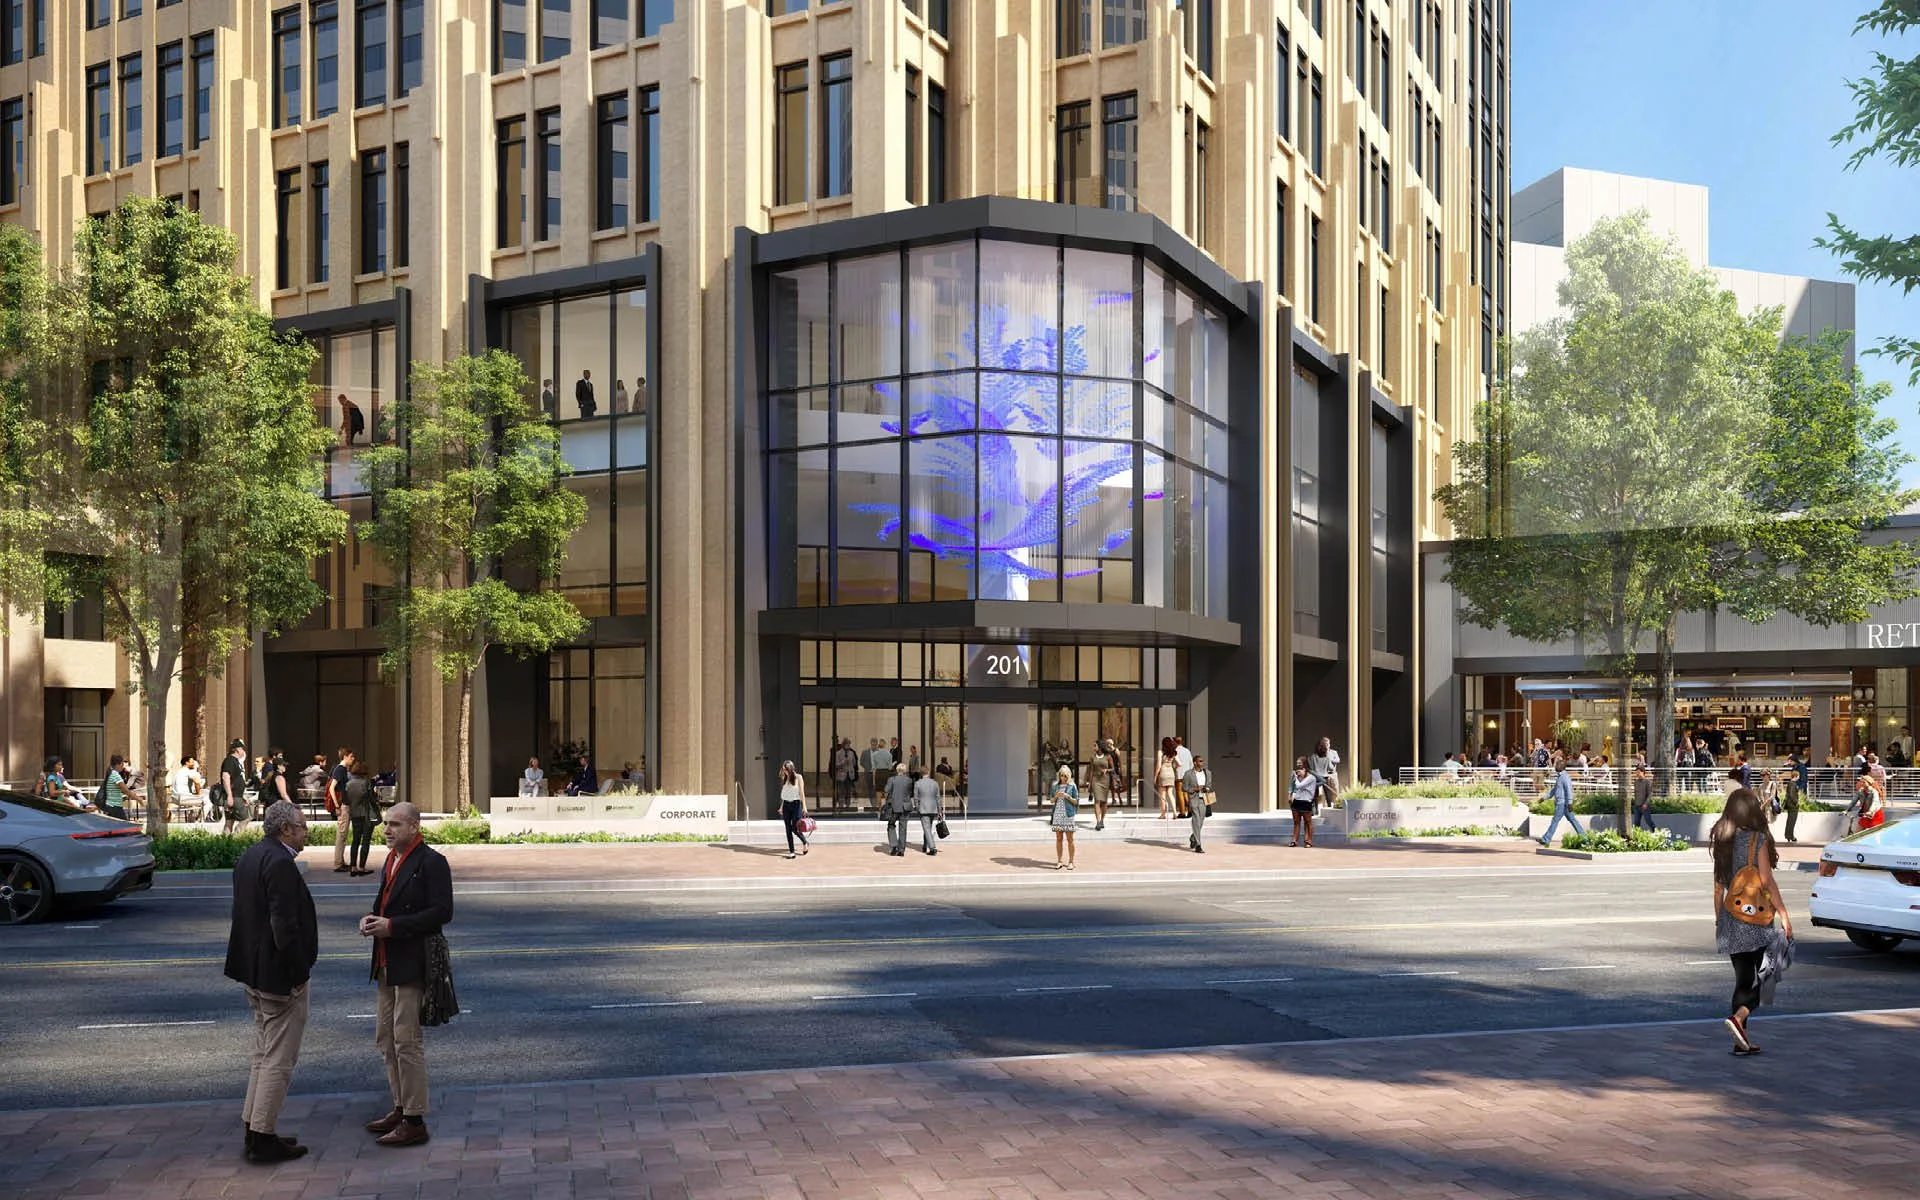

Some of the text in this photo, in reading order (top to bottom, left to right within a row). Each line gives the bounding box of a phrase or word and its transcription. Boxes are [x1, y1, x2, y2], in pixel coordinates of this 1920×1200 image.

[1867, 623, 1920, 649] RET
[986, 655, 1021, 675] 201
[660, 810, 716, 819] CORPORATE
[1354, 810, 1397, 821] Corporate
